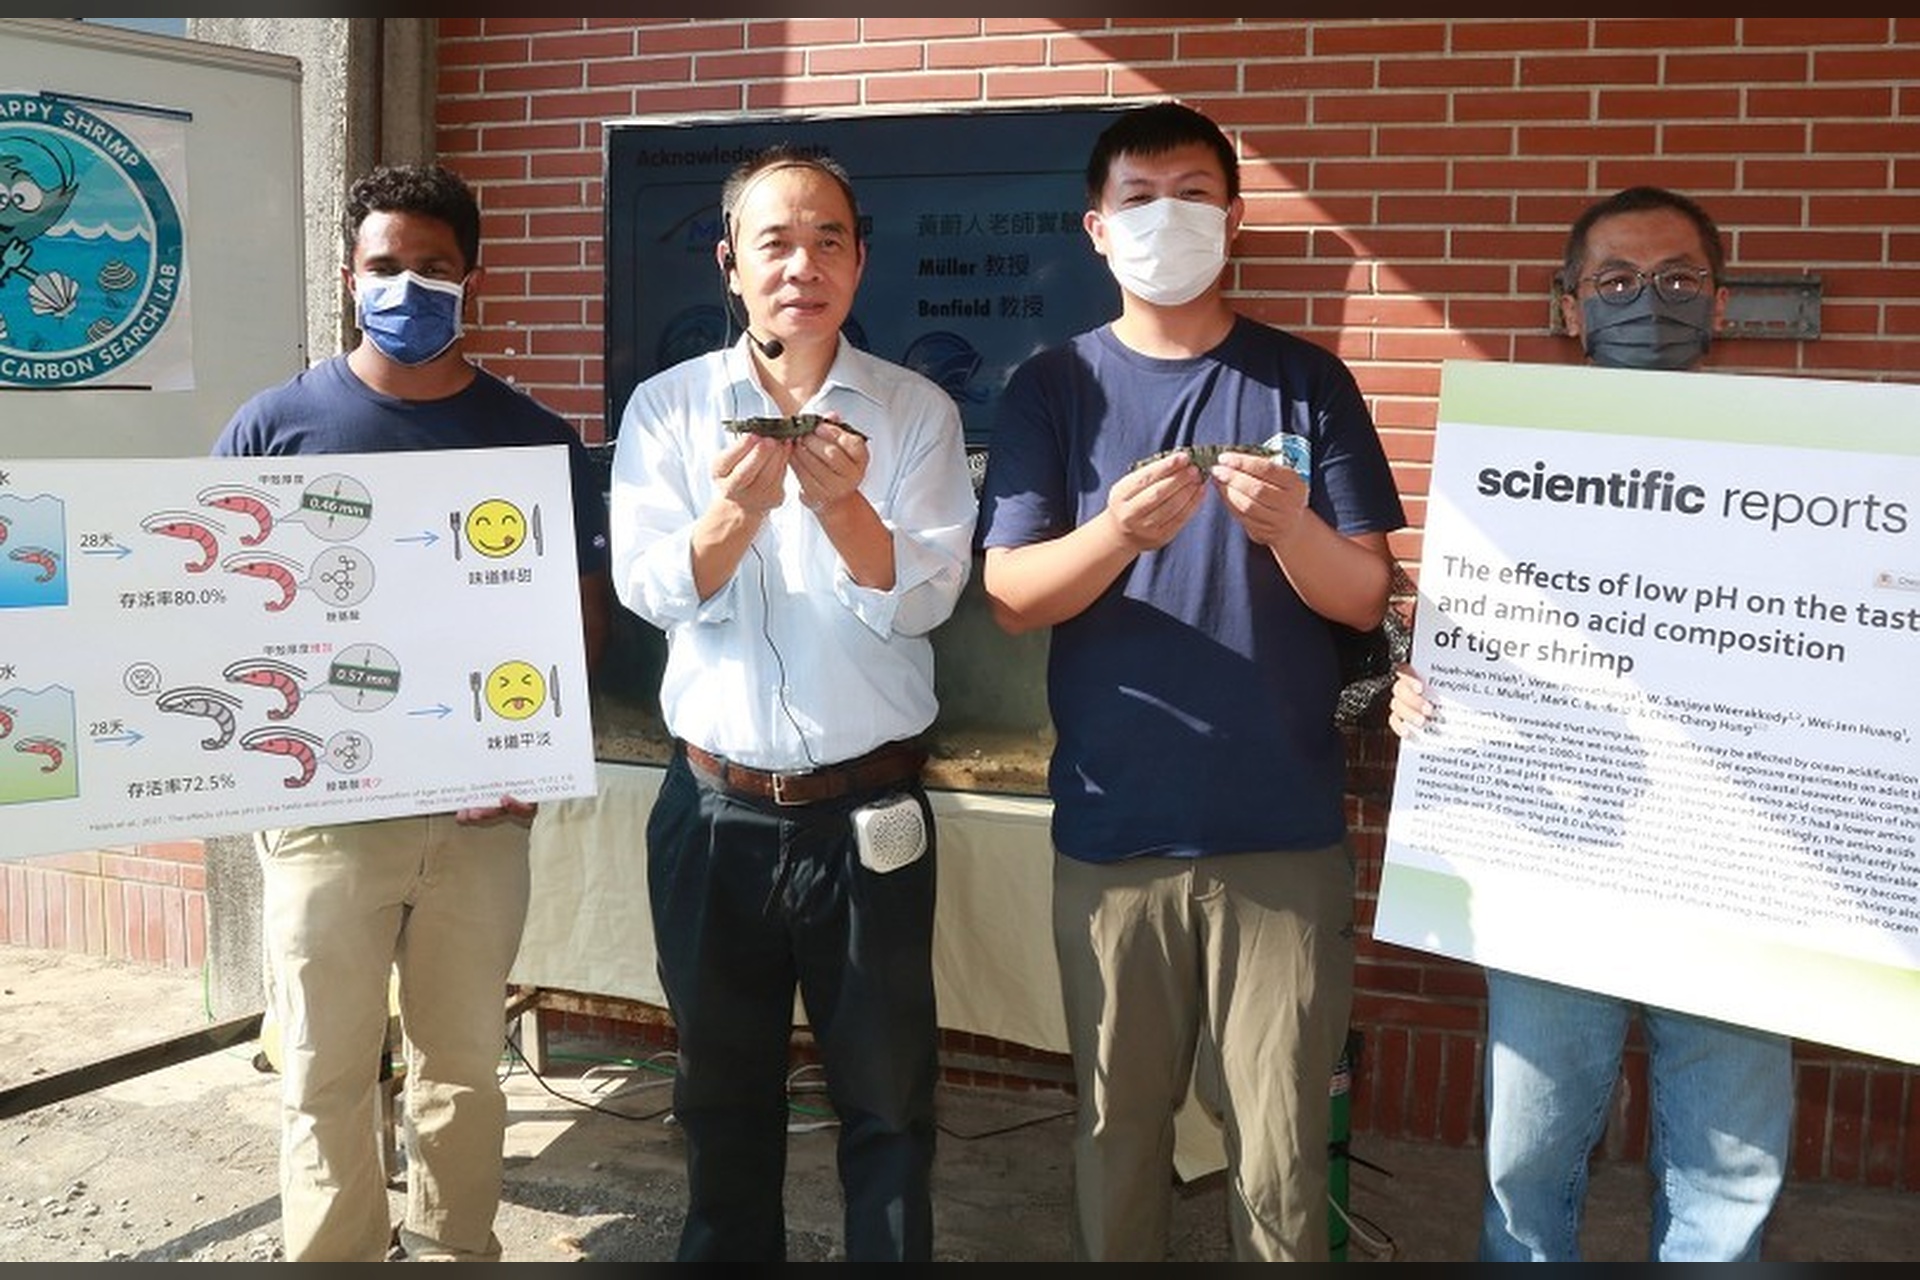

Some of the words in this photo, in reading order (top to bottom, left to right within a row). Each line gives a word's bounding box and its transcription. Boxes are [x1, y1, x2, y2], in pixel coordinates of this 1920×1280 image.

[62, 109, 141, 169] SHRIMP
[636, 145, 831, 167] Acknowledgnts
[918, 256, 977, 276] Müller
[985, 253, 1030, 278] 教授
[1, 356, 95, 380] CARBON
[100, 301, 166, 367] SEARCH
[155, 263, 177, 302] LAB
[999, 293, 1044, 319] 教授
[309, 497, 337, 512] 0.46
[338, 502, 364, 516] mm
[1477, 461, 1706, 515] scientific
[1723, 488, 1907, 534] reports
[80, 532, 115, 549] 28天
[119, 587, 227, 610] 存活率80.0%
[1444, 556, 1489, 580] The
[1499, 562, 1591, 593] effects
[1598, 573, 1631, 597] of
[1635, 574, 1688, 604] low
[1694, 585, 1738, 613] pH
[1747, 595, 1785, 616] on
[1794, 594, 1847, 623] the
[1855, 603, 1920, 632] tast
[1438, 591, 1487, 617] and
[1495, 601, 1580, 628] amino
[1588, 610, 1646, 637] acid
[1654, 622, 1845, 663] composition
[335, 668, 364, 680] 0.57
[1434, 624, 1463, 650] of
[1466, 631, 1530, 662] tiger
[1538, 640, 1634, 678] shrimp
[1540, 693, 1569, 705] Mark
[1569, 697, 1582, 707] C.
[1646, 693, 1662, 703] W.
[1664, 695, 1712, 713] Sanjaya
[1806, 715, 1859, 731] Wei-Jen
[89, 718, 124, 736] 28天
[1517, 715, 1561, 730] revealed
[1562, 722, 1585, 733] that
[1586, 726, 1622, 742] shrimp
[1703, 745, 1728, 758] may
[1729, 747, 1745, 758] be
[1746, 750, 1793, 765] affected
[1793, 757, 1809, 771] by
[1809, 761, 1845, 773] ocean
[1845, 765, 1919, 785] acidification
[127, 772, 237, 798] 存活率72.5%
[1488, 739, 1512, 749] were
[1512, 741, 1536, 756] kept
[1537, 745, 1547, 754] in
[1584, 753, 1613, 765] tanks
[1731, 776, 1756, 788] with
[1757, 780, 1798, 795] coastal
[1857, 796, 1877, 808] We
[1525, 757, 1577, 776] properties
[1578, 765, 1598, 776] and
[1599, 769, 1623, 781] flesh
[1748, 793, 1784, 807] amino
[1784, 799, 1809, 811] acid
[1809, 803, 1883, 827] composition
[1884, 815, 1897, 826] of
[1786, 771, 1858, 793] experiments
[1859, 784, 1875, 793] on
[1877, 785, 1909, 798] adult
[1417, 765, 1437, 776] acid
[1823, 834, 1844, 847] the
[1845, 838, 1884, 853] amino
[1885, 845, 1916, 859] acids
[1418, 752, 1458, 769] exposed
[1459, 759, 1470, 769] to
[1470, 761, 1486, 774] pH
[1486, 764, 1502, 774] 7.5
[1503, 766, 1522, 777] and
[1523, 770, 1539, 783] pH
[1615, 785, 1629, 795] for
[1788, 814, 1807, 825] 7.5
[1808, 817, 1831, 830] had
[1832, 823, 1840, 831] a
[1841, 823, 1875, 837] lower
[1876, 828, 1916, 844] amino
[1414, 790, 1442, 803] levels
[1442, 795, 1451, 805] in
[1452, 797, 1469, 808] the
[1486, 803, 1501, 814] 7.5
[1501, 806, 1526, 818] than
[1527, 810, 1543, 822] the
[1544, 813, 1560, 827] pH
[1561, 816, 1578, 828] 8.0
[1825, 866, 1838, 875] as
[1839, 866, 1862, 879] less
[1863, 870, 1919, 889] desirable
[1470, 787, 1484, 798] for
[1484, 790, 1502, 801] the
[1812, 847, 1825, 858] at
[1826, 849, 1897, 874] significantly
[1527, 824, 1576, 841] volunteer
[1841, 883, 1868, 898] may
[1870, 886, 1917, 904] become
[1853, 898, 1896, 918] shrimp
[1881, 920, 1919, 934] ocean
